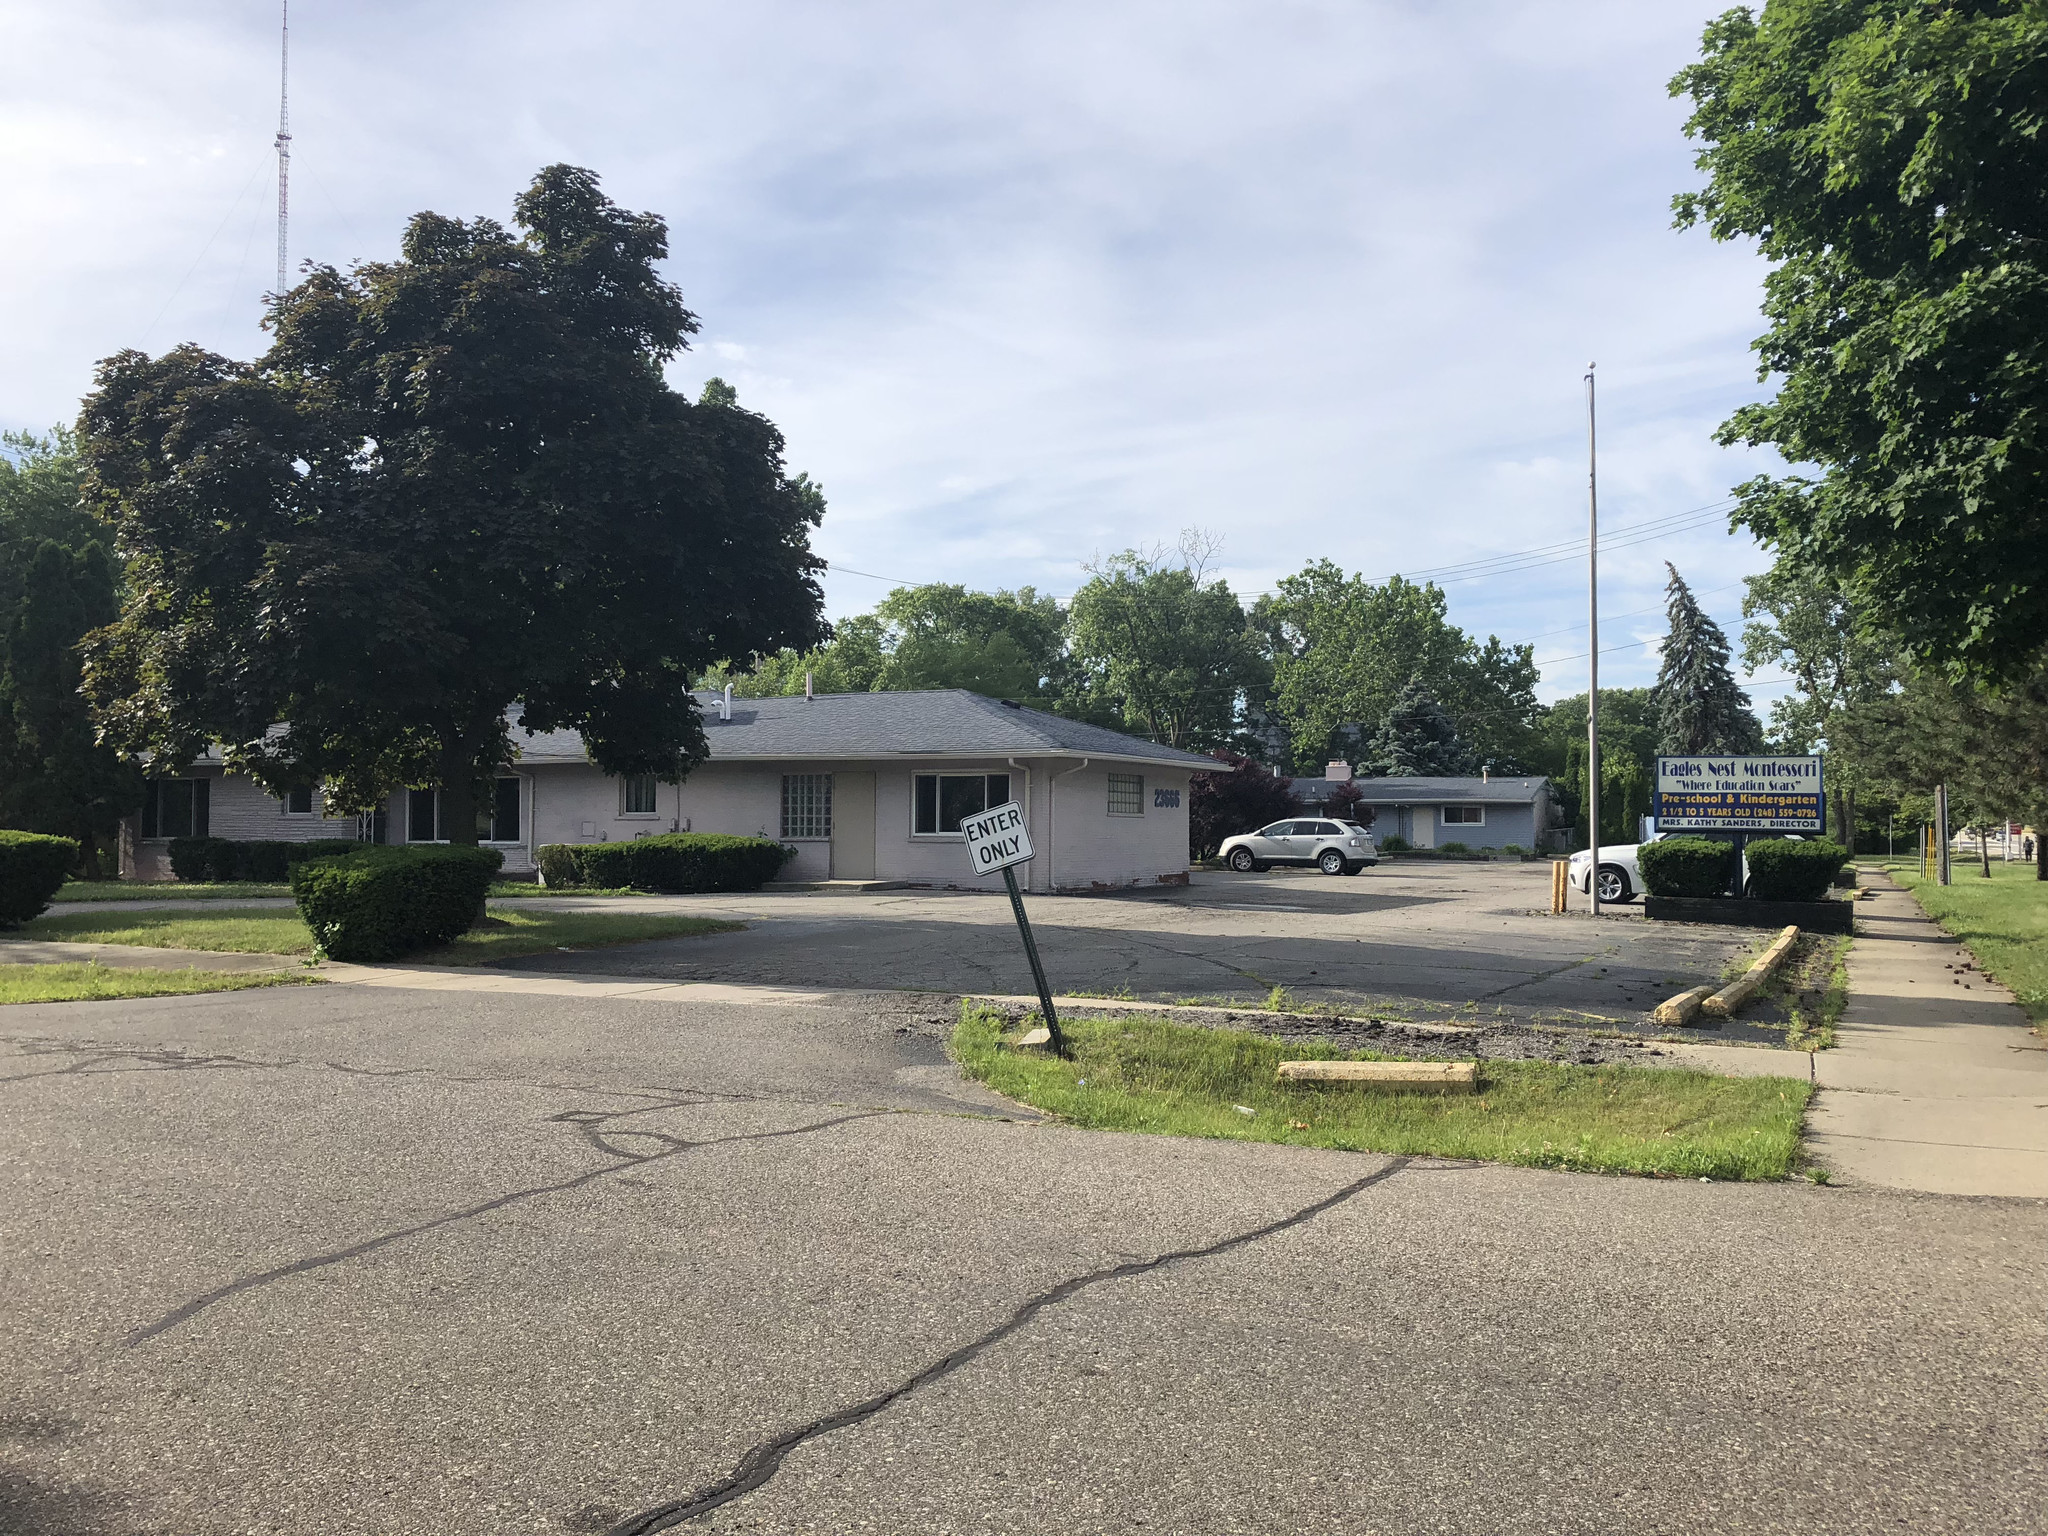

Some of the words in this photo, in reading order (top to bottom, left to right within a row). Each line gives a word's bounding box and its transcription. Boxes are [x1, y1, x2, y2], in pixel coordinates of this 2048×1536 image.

[1661, 761, 1702, 777] Eagles
[1708, 761, 1736, 777] Nest
[1743, 760, 1817, 777] Montessori
[1716, 780, 1765, 791] Education
[1661, 793, 1721, 803] Pre-school
[1726, 794, 1735, 803] &
[1740, 793, 1817, 805] Kindergarten
[1670, 808, 1683, 816] 1/2
[1686, 808, 1697, 816] TO
[1707, 808, 1731, 816] YEARS
[1735, 808, 1751, 816] OLD
[1754, 808, 1776, 818] (248)
[1779, 809, 1817, 818] 559-0726
[966, 809, 1021, 842] ENTER
[1687, 819, 1718, 827] KATHY
[1721, 819, 1766, 828] SANDERS,
[1770, 820, 1817, 828] DIRECTOR
[980, 835, 1020, 864] ONLY
